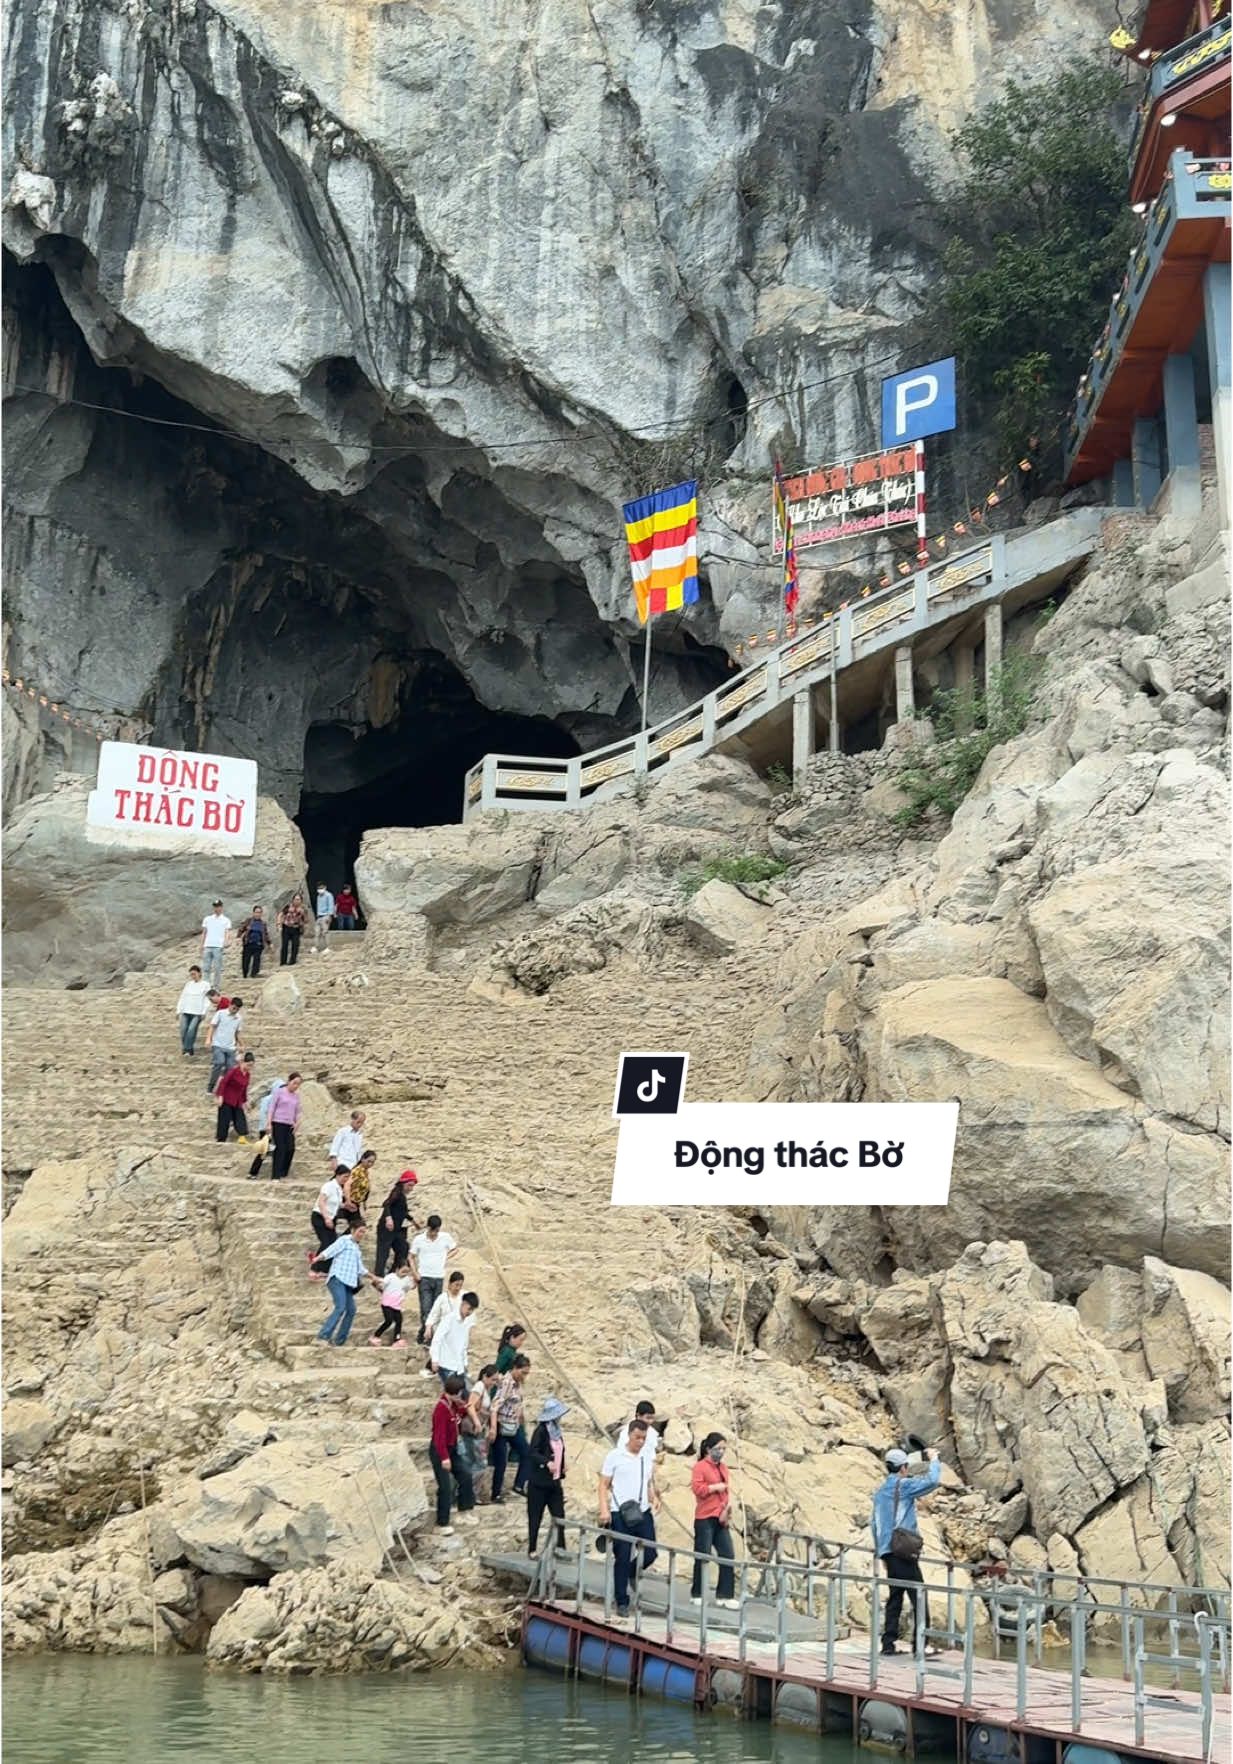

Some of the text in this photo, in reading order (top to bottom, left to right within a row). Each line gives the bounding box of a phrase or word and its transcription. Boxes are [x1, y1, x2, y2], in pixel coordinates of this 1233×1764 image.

[895, 374, 938, 435] P
[137, 750, 219, 792] ĐỘNG
[115, 789, 245, 833] THÁC BỜ
